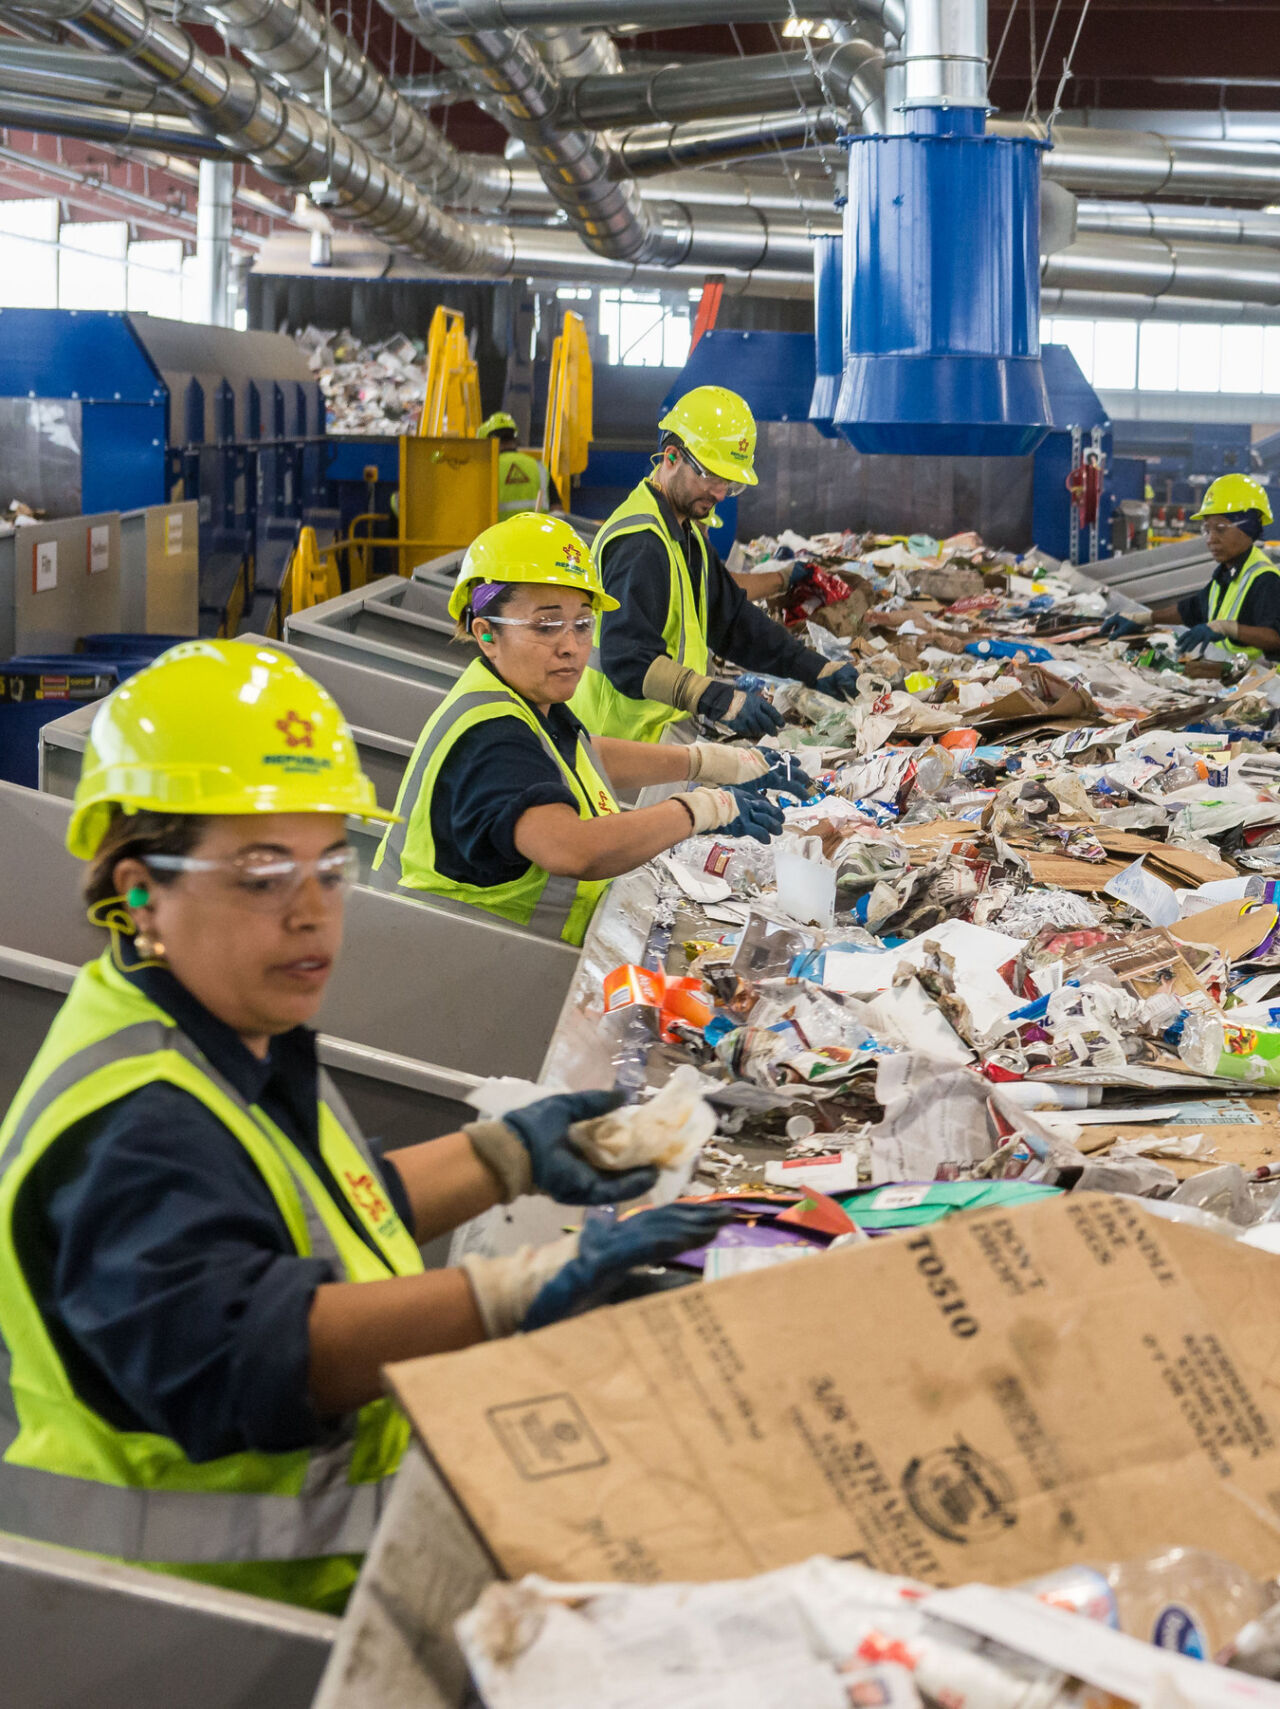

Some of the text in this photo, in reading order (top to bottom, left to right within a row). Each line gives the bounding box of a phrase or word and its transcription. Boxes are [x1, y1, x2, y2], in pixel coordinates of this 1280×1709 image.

[1066, 1202, 1114, 1267] EGGS
[1088, 1198, 1128, 1249] LIKE
[1110, 1195, 1178, 1289] HANDLE
